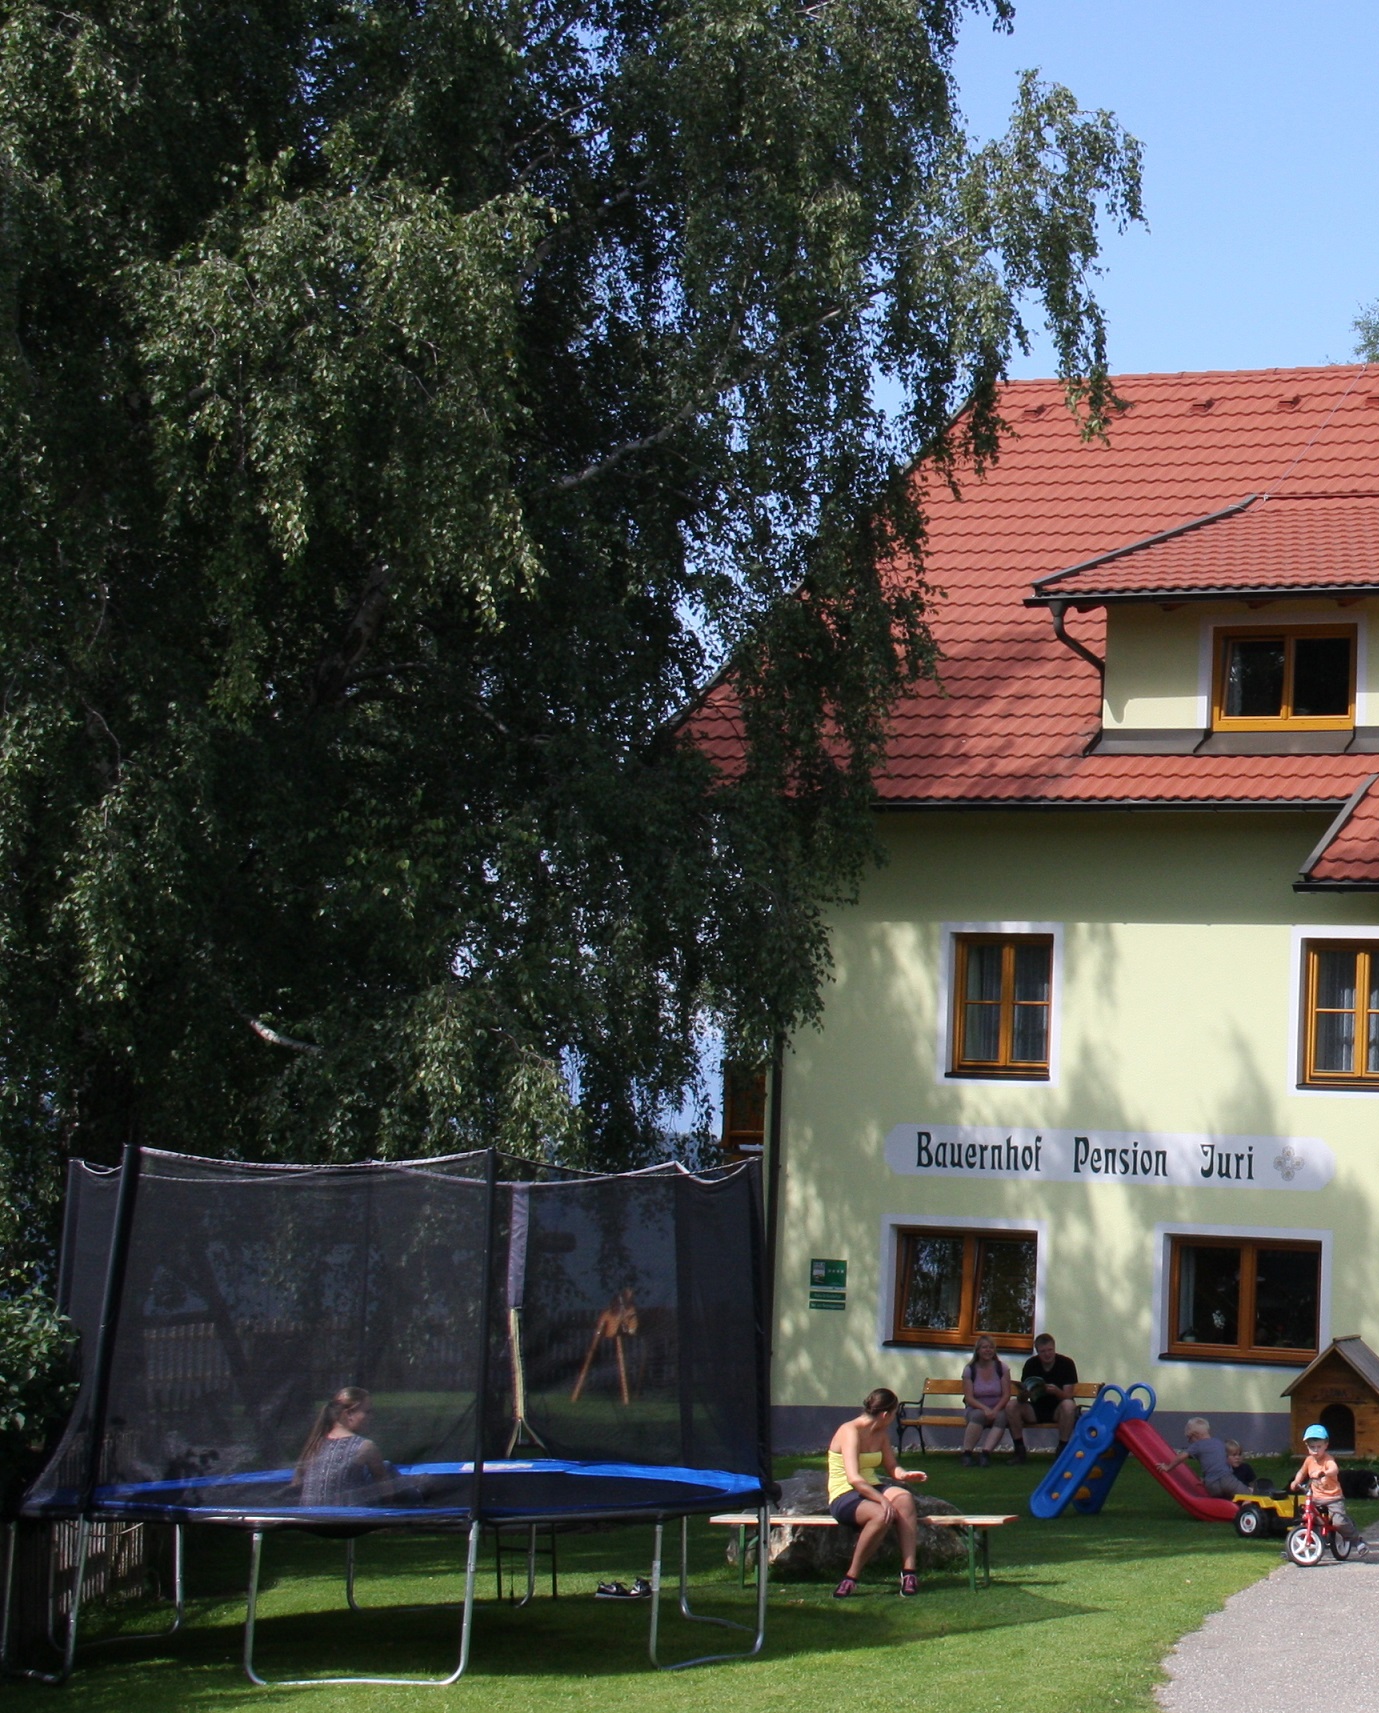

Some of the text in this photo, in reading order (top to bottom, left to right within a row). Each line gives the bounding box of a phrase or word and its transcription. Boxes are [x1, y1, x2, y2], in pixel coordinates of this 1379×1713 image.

[916, 1131, 1255, 1180] Bauernhof Pension Juri
